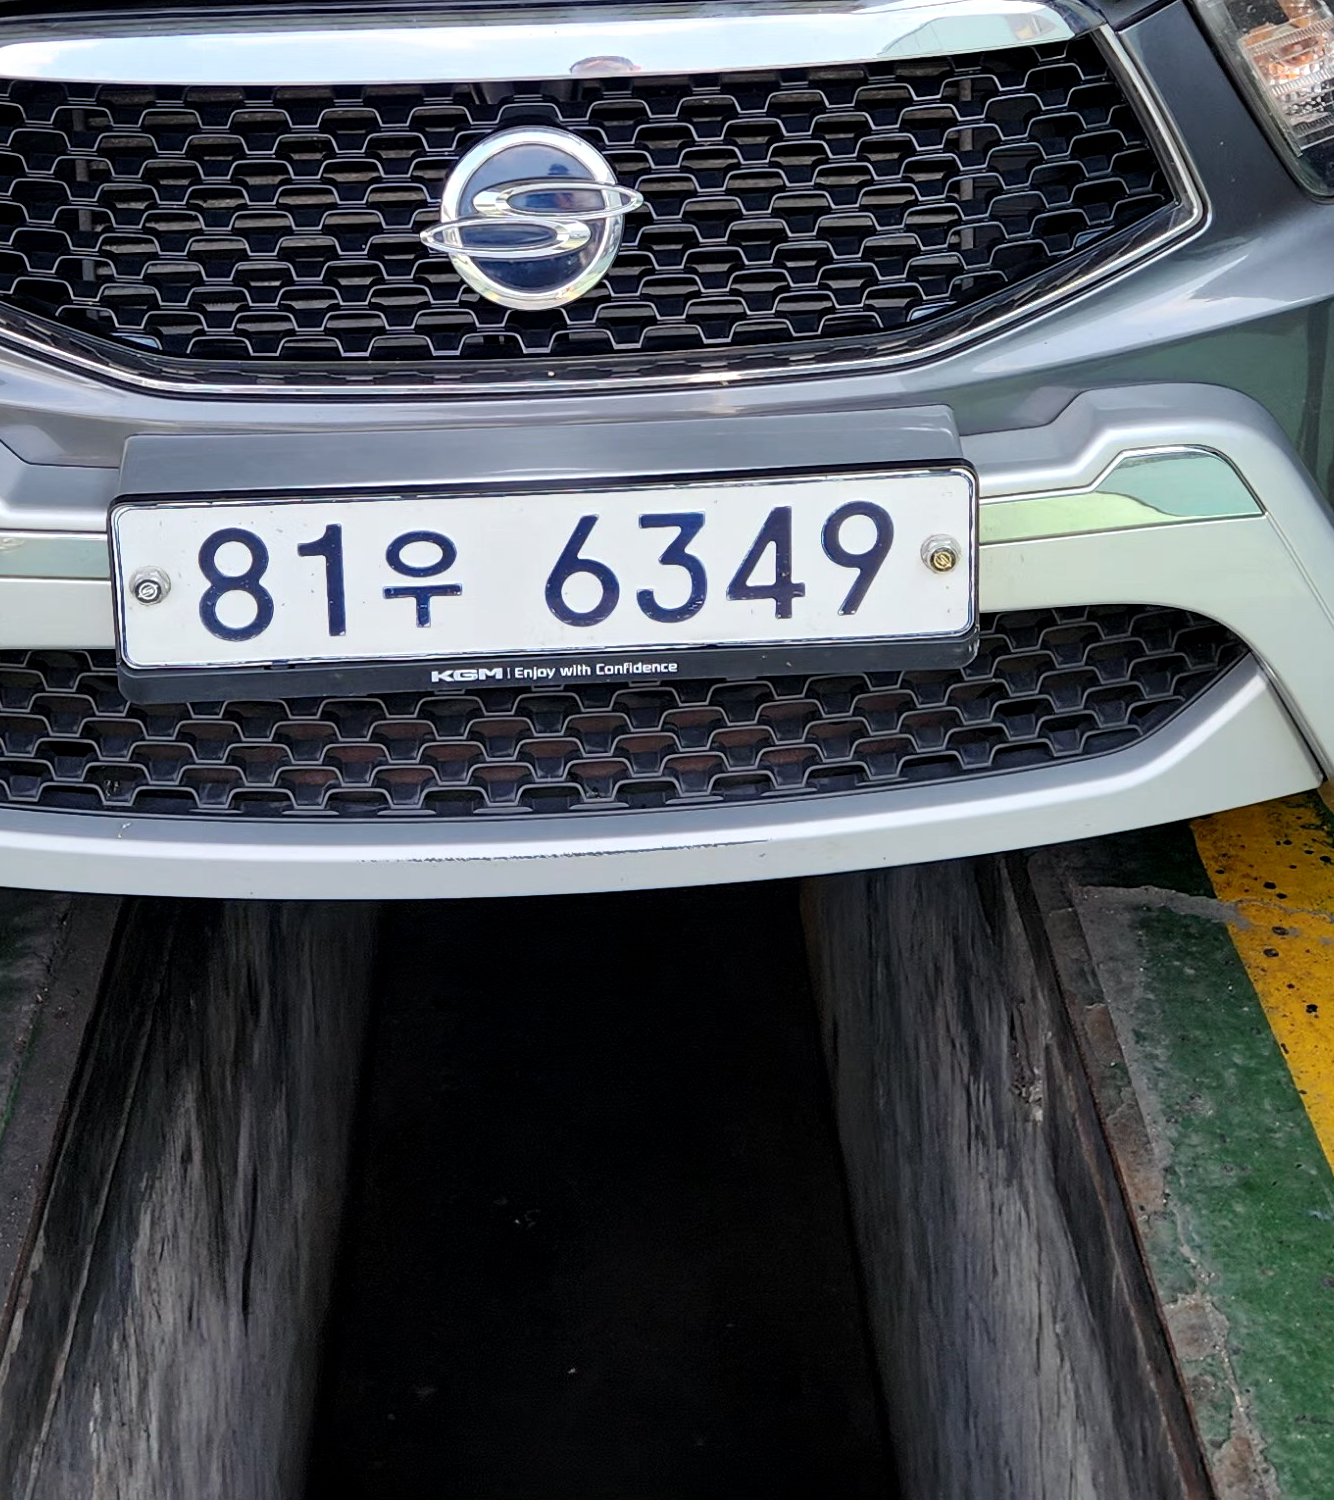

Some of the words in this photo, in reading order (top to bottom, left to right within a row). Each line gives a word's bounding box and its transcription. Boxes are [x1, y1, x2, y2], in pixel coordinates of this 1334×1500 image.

[196, 522, 464, 642] 81우
[544, 500, 895, 629] 6349
[431, 667, 504, 684] KGM
[514, 665, 556, 680] Enjoy
[559, 663, 591, 677] with
[595, 661, 679, 676] Confidence
